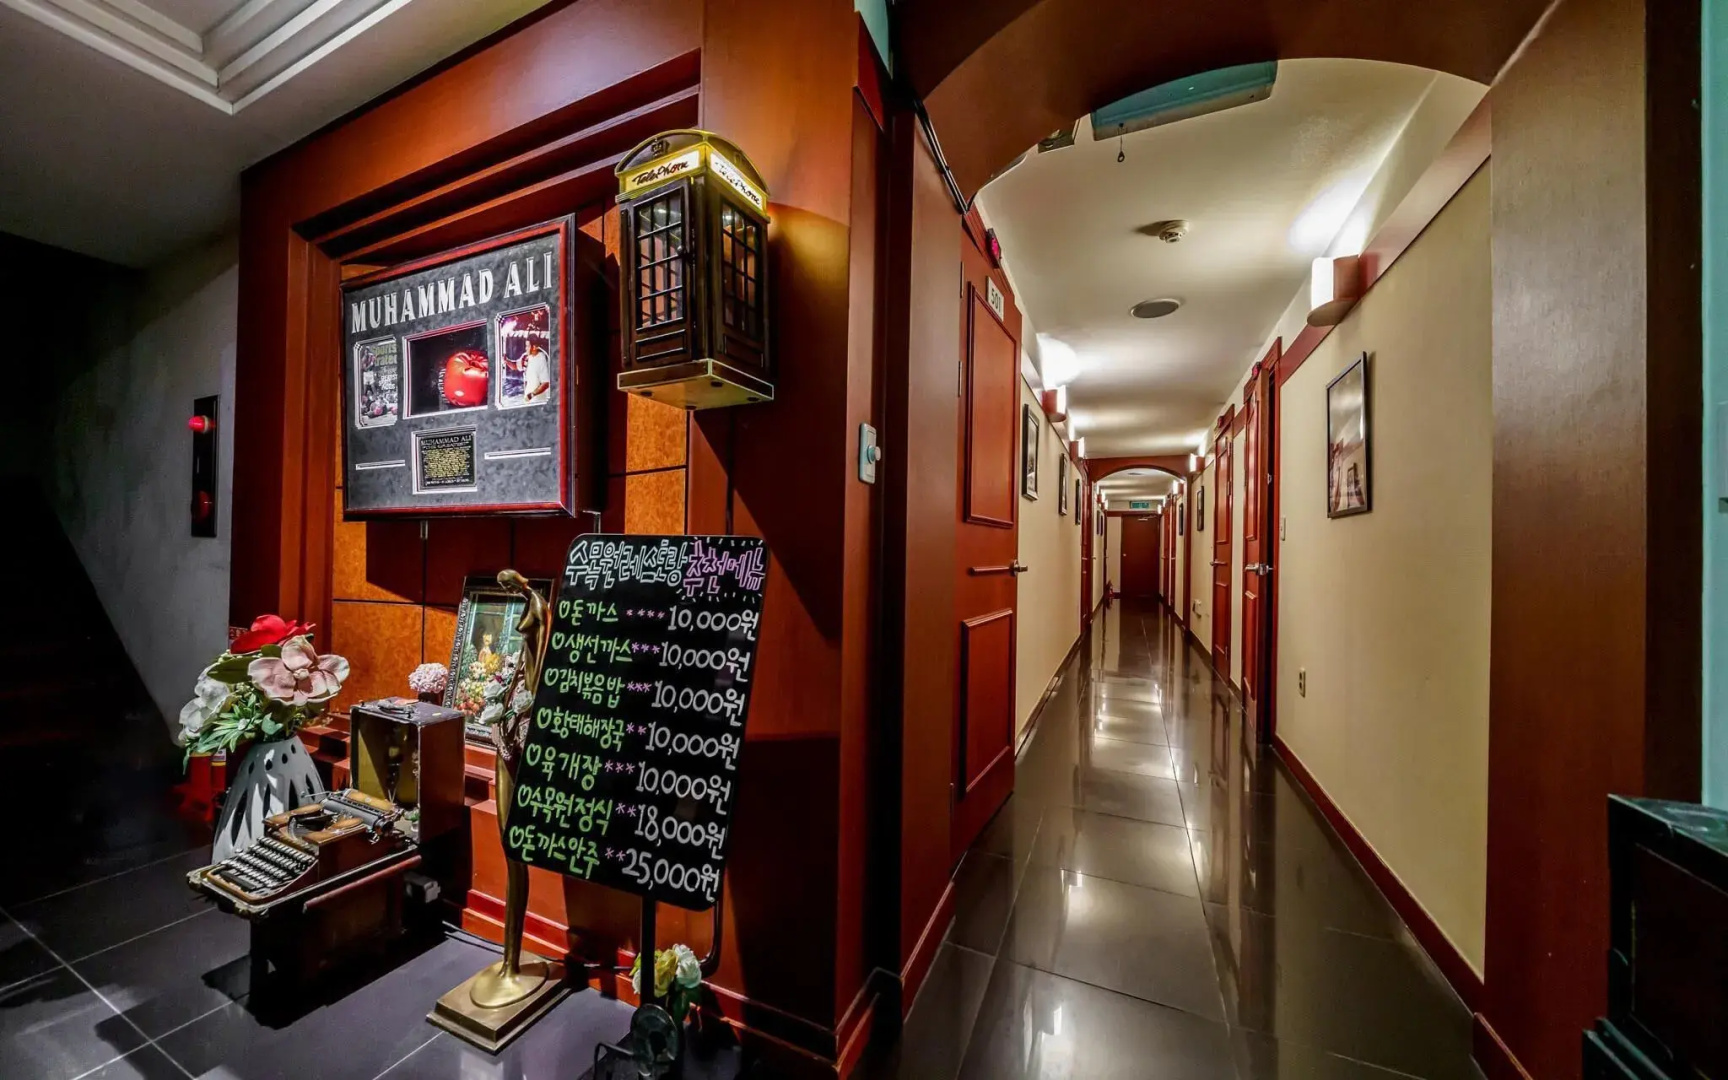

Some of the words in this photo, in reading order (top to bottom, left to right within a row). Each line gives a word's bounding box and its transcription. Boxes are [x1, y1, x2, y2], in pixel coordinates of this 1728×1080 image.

[351, 268, 494, 334] MUHAMMAD
[503, 252, 553, 298] ALI
[683, 540, 766, 597] 추천메뉴
[667, 605, 759, 641] 10,000원
[568, 633, 633, 664] 생선까스
[659, 641, 751, 683] 10,000원
[651, 680, 745, 727] 10,000원
[551, 706, 626, 752] 황태해장국
[645, 721, 741, 771] 10,000원
[541, 746, 603, 791] 육개장
[636, 761, 732, 815] 10,000원
[634, 804, 726, 860] 18,000원
[621, 848, 720, 902] 25,000원
